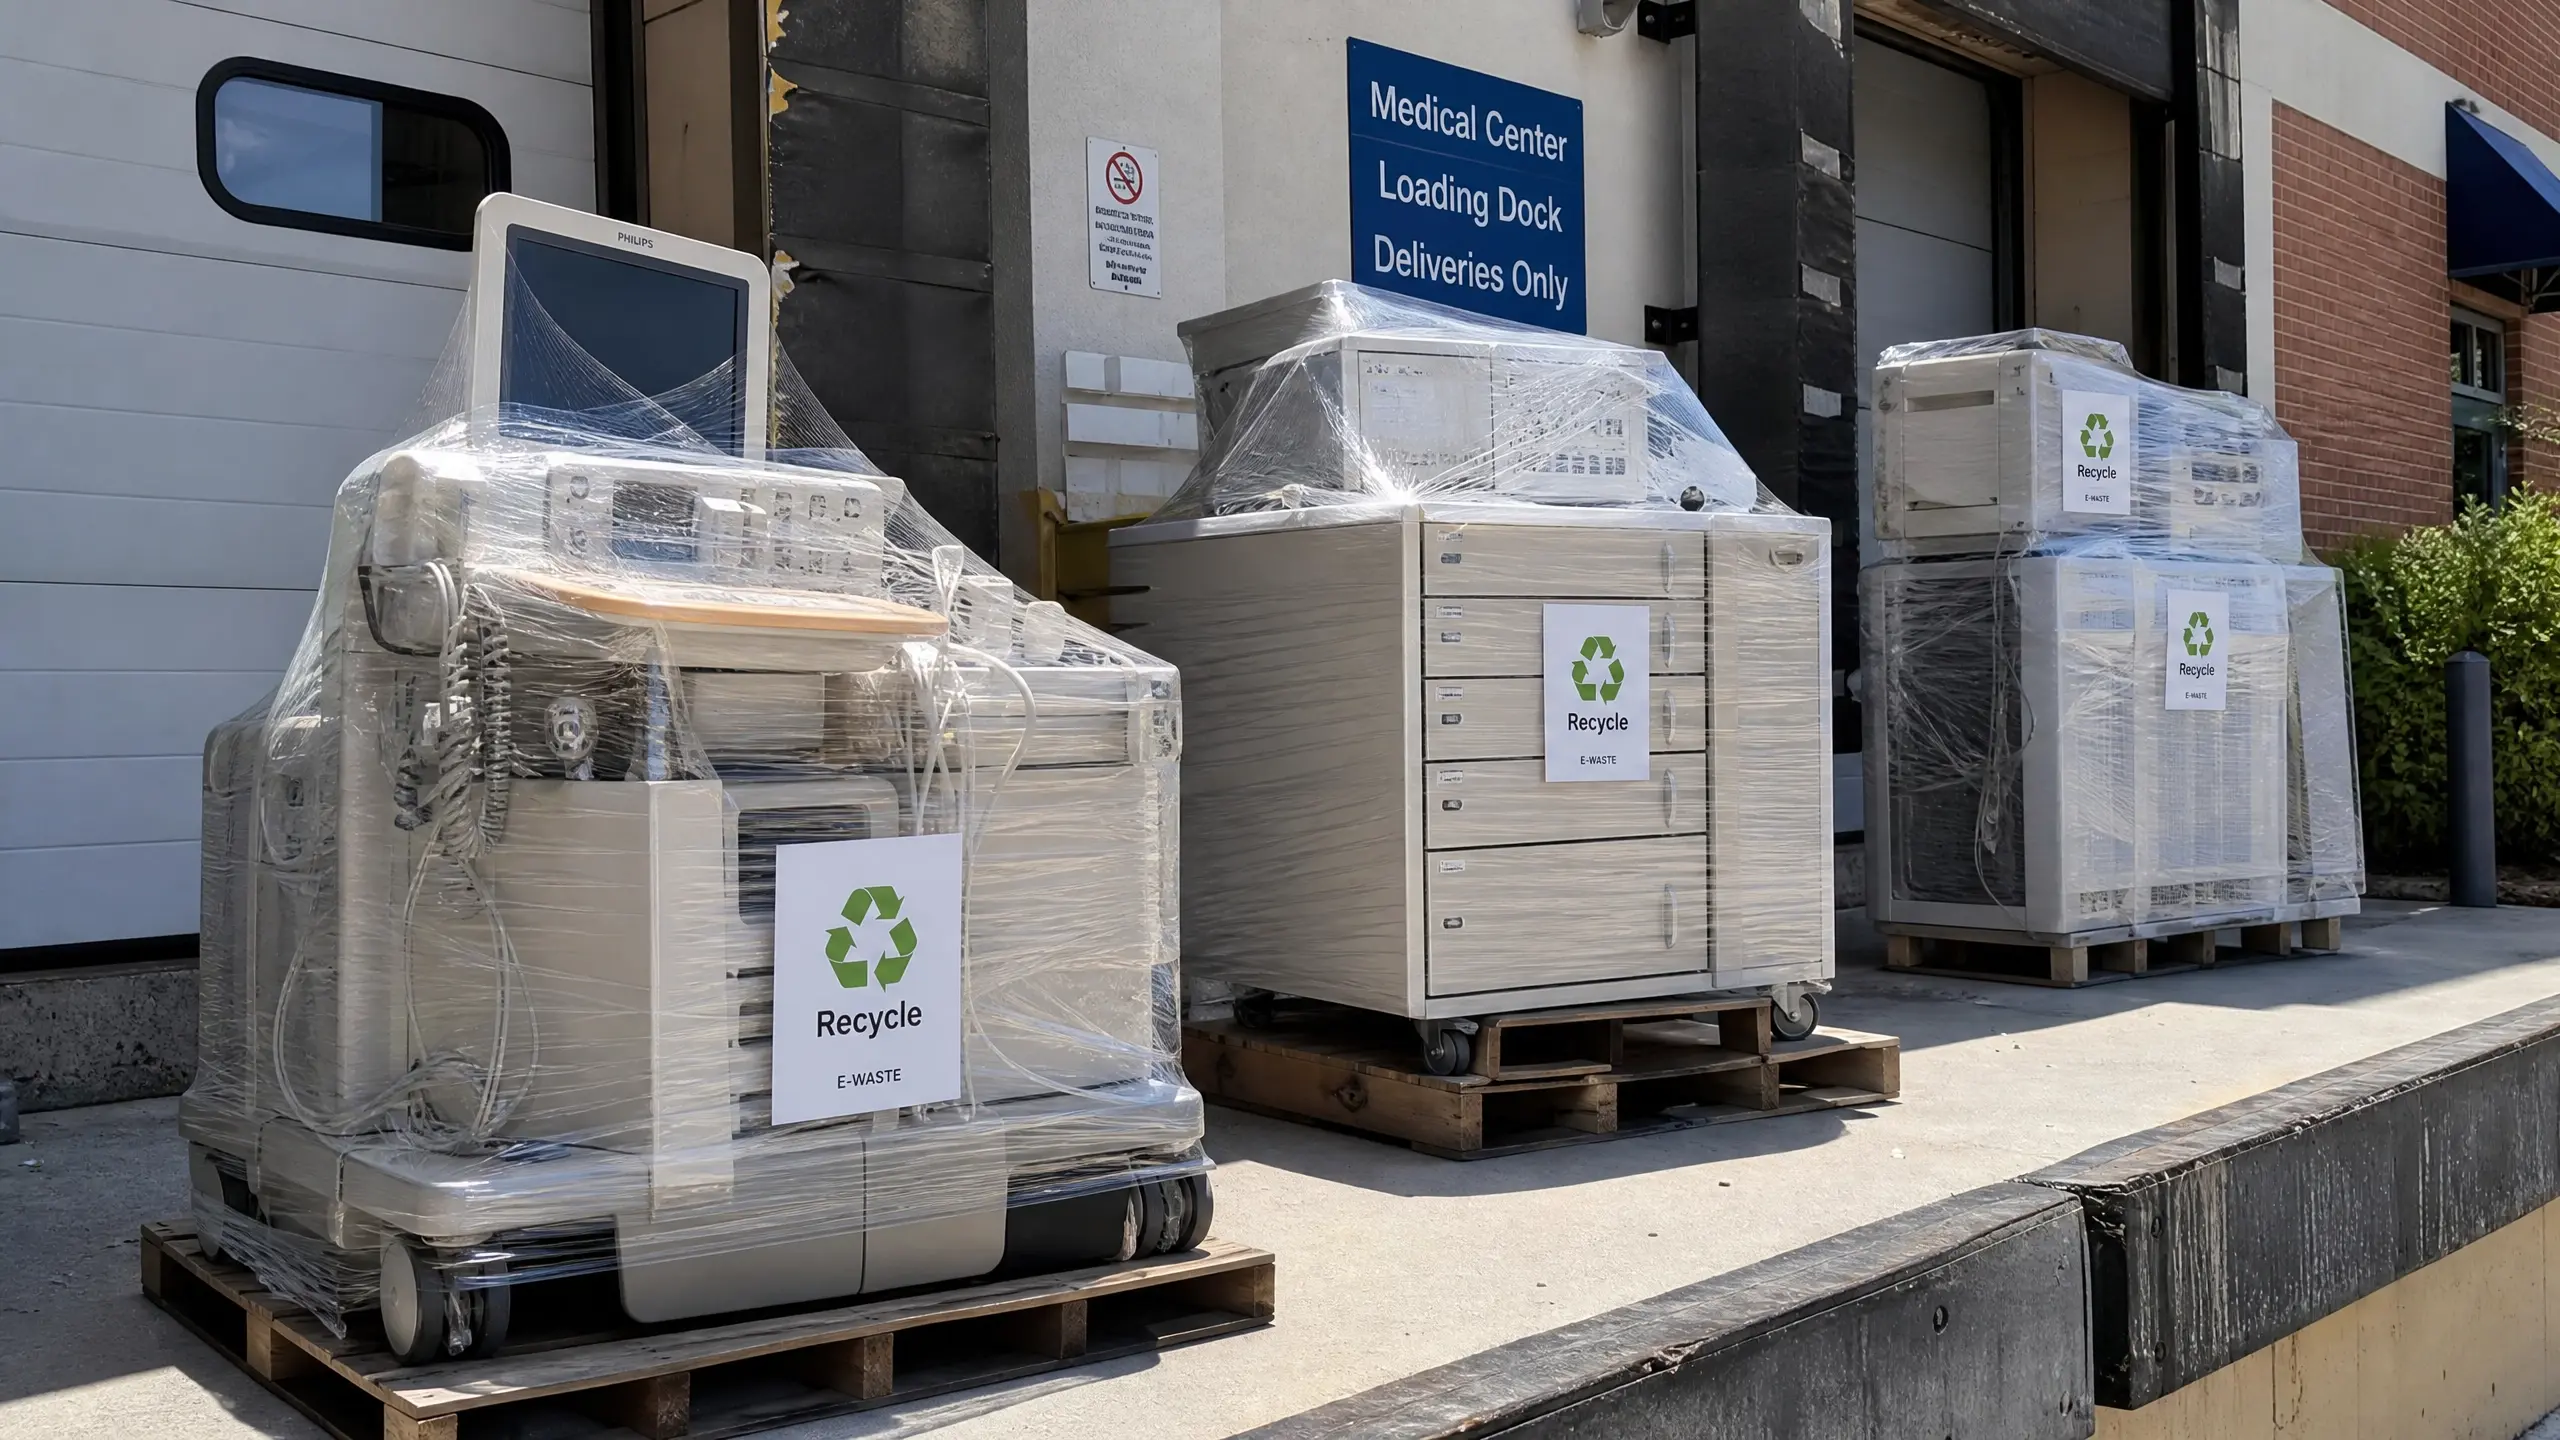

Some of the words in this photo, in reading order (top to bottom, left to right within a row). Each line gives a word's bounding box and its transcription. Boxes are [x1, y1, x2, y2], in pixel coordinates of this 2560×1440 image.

[1371, 81, 1477, 141] Medical
[1486, 110, 1567, 162] Center
[1379, 160, 1488, 227] Loading
[1499, 186, 1563, 232] Dock
[618, 232, 653, 248] PHILIPS
[1374, 234, 1504, 292] Deliveries
[1512, 260, 1568, 311] Only
[2078, 464, 2116, 481] Recycle
[2180, 663, 2214, 679] Recycle
[1568, 712, 1628, 735] Recycle
[1580, 756, 1616, 764] E-WASTE
[817, 1000, 922, 1039] Recycle
[837, 1068, 902, 1089] E-WASTE
